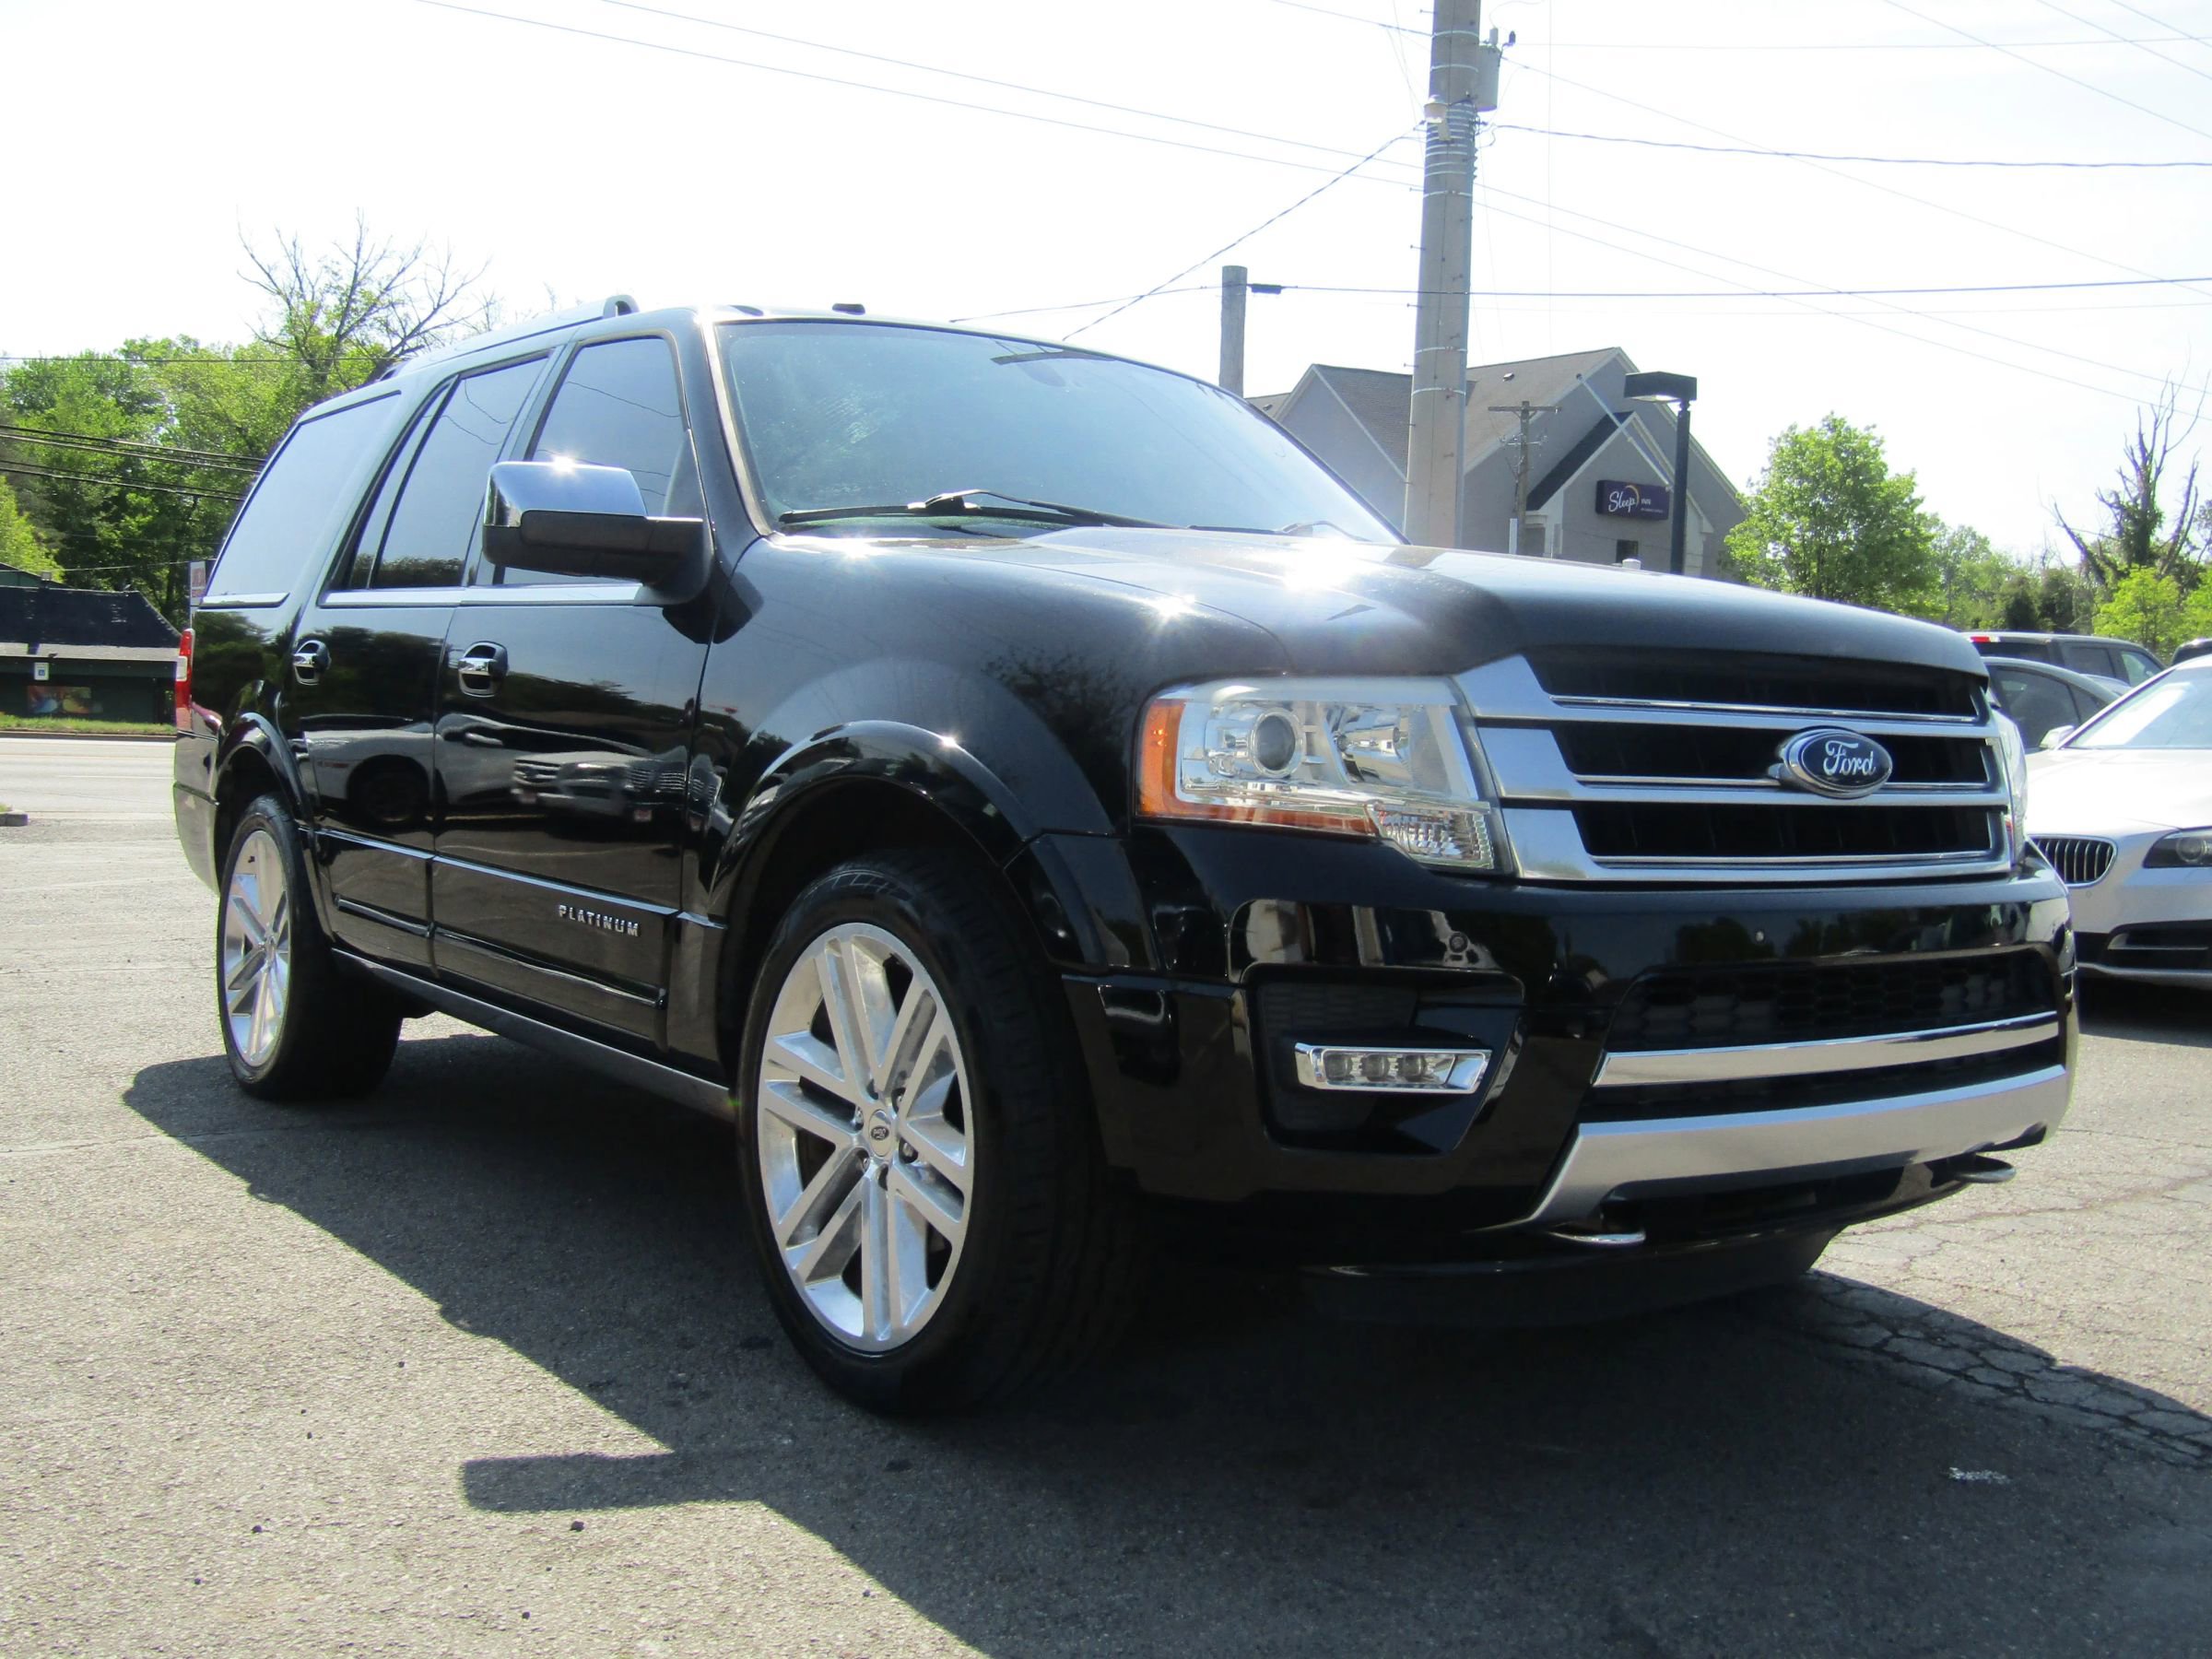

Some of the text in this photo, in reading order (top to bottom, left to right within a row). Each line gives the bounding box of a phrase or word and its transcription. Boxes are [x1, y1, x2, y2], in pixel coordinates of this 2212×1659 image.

[1608, 490, 1636, 512] Sleep
[1823, 740, 1876, 776] Ford
[559, 904, 639, 937] PLATINUM
